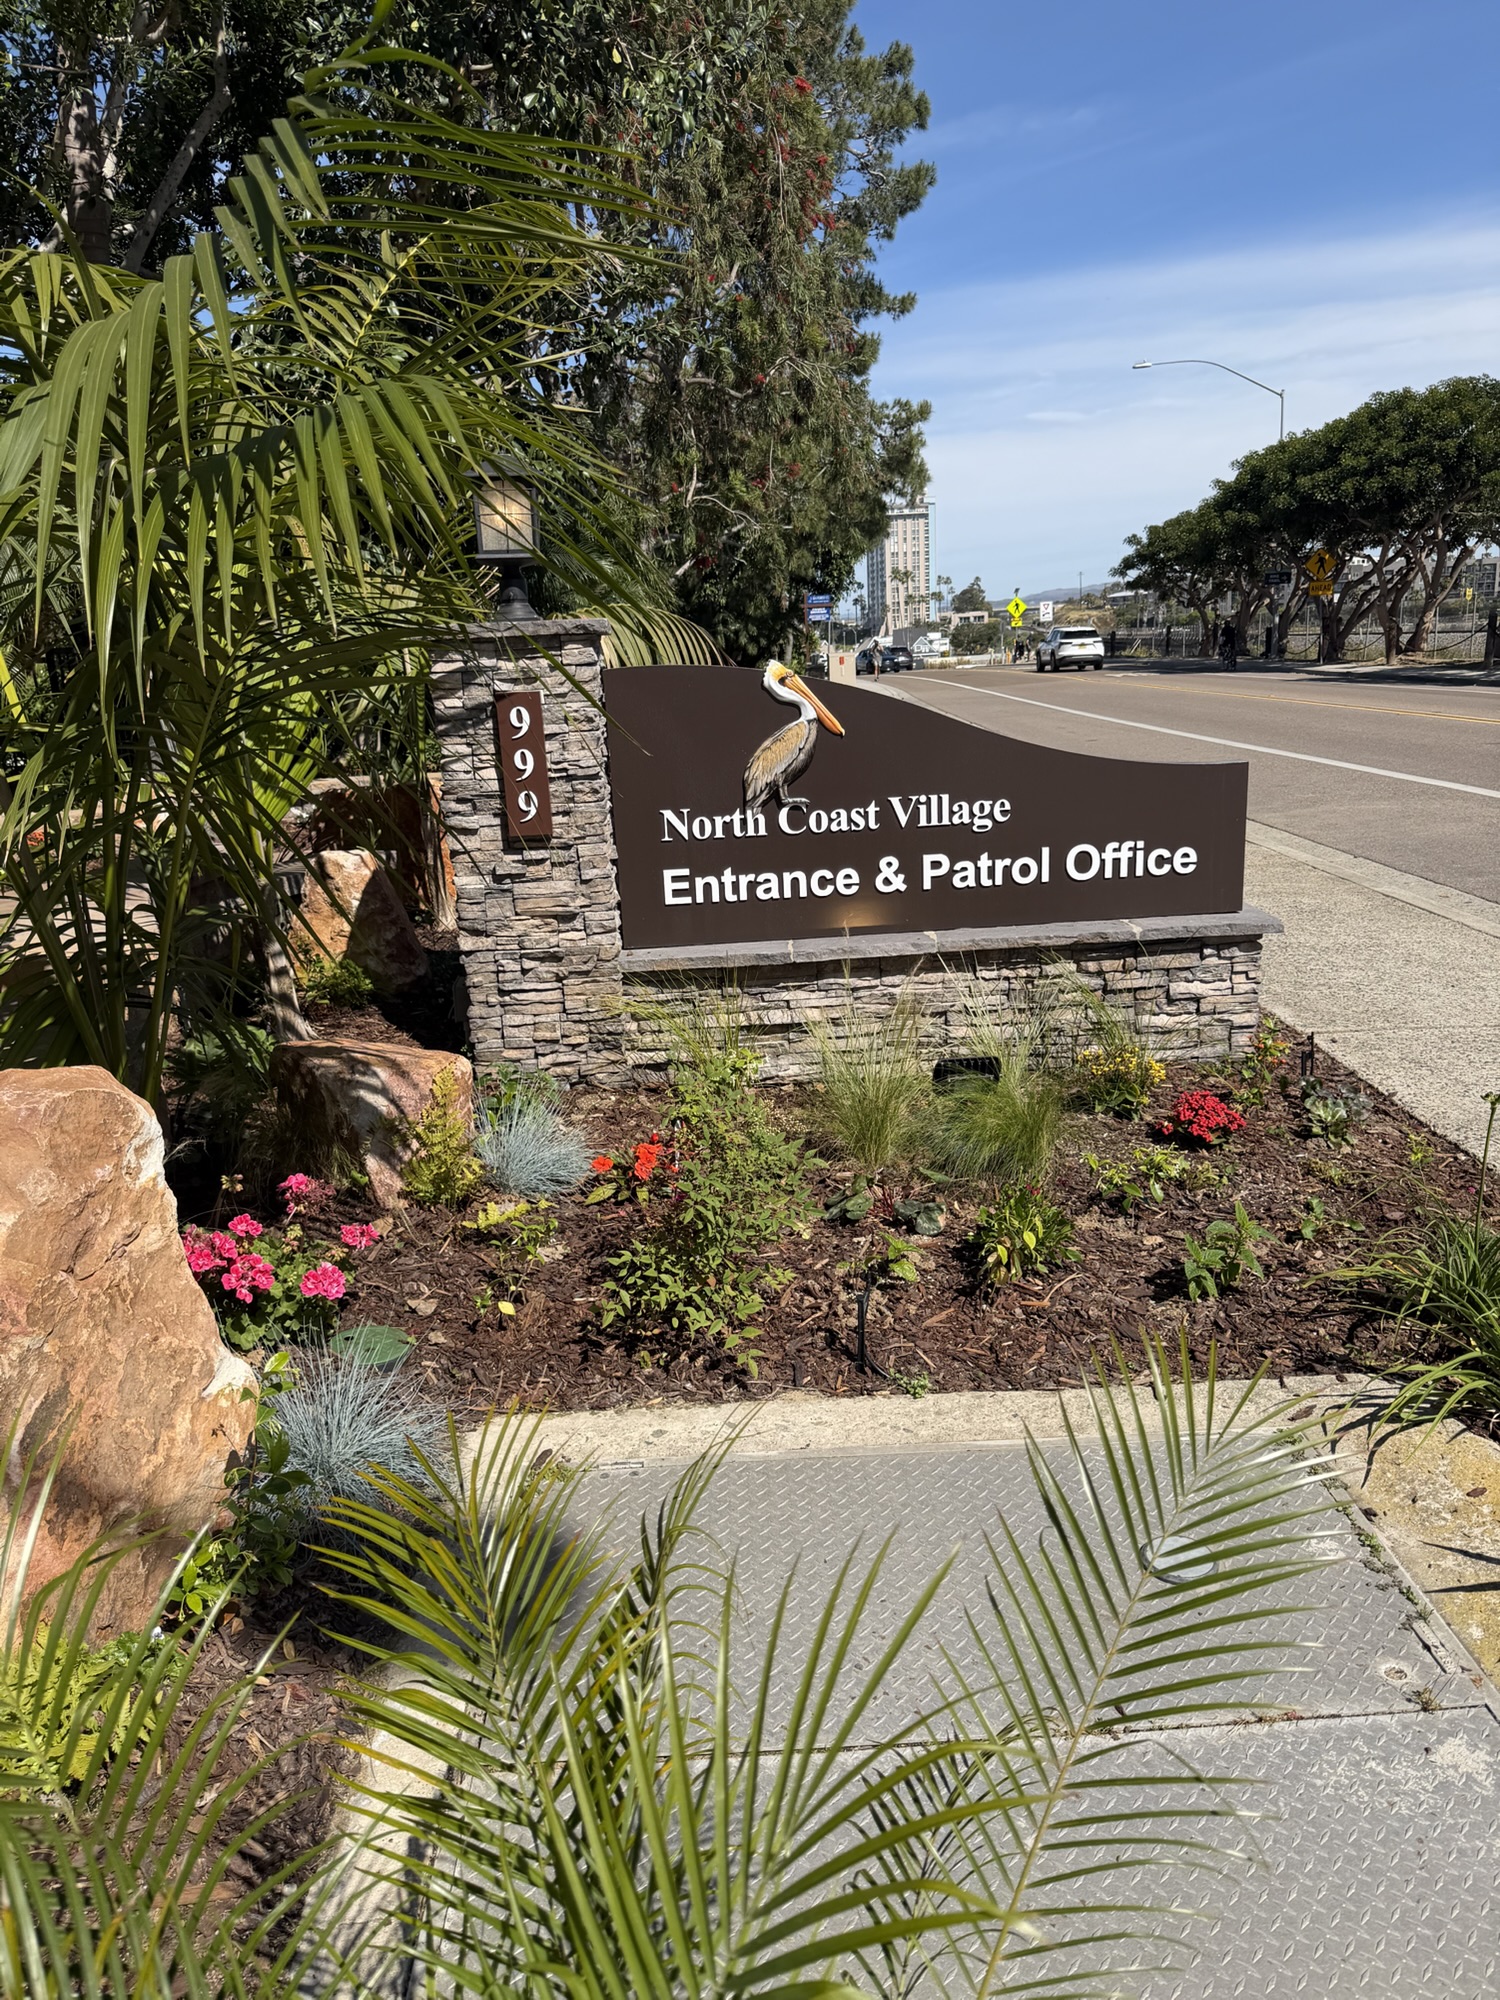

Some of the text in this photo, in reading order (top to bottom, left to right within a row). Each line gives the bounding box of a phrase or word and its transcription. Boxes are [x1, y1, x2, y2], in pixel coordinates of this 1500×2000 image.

[1311, 583, 1332, 592] AHEAD
[509, 705, 539, 823] 999
[659, 793, 1012, 842] North Coast Village
[662, 840, 1198, 906] Entrance & Patrol Office
